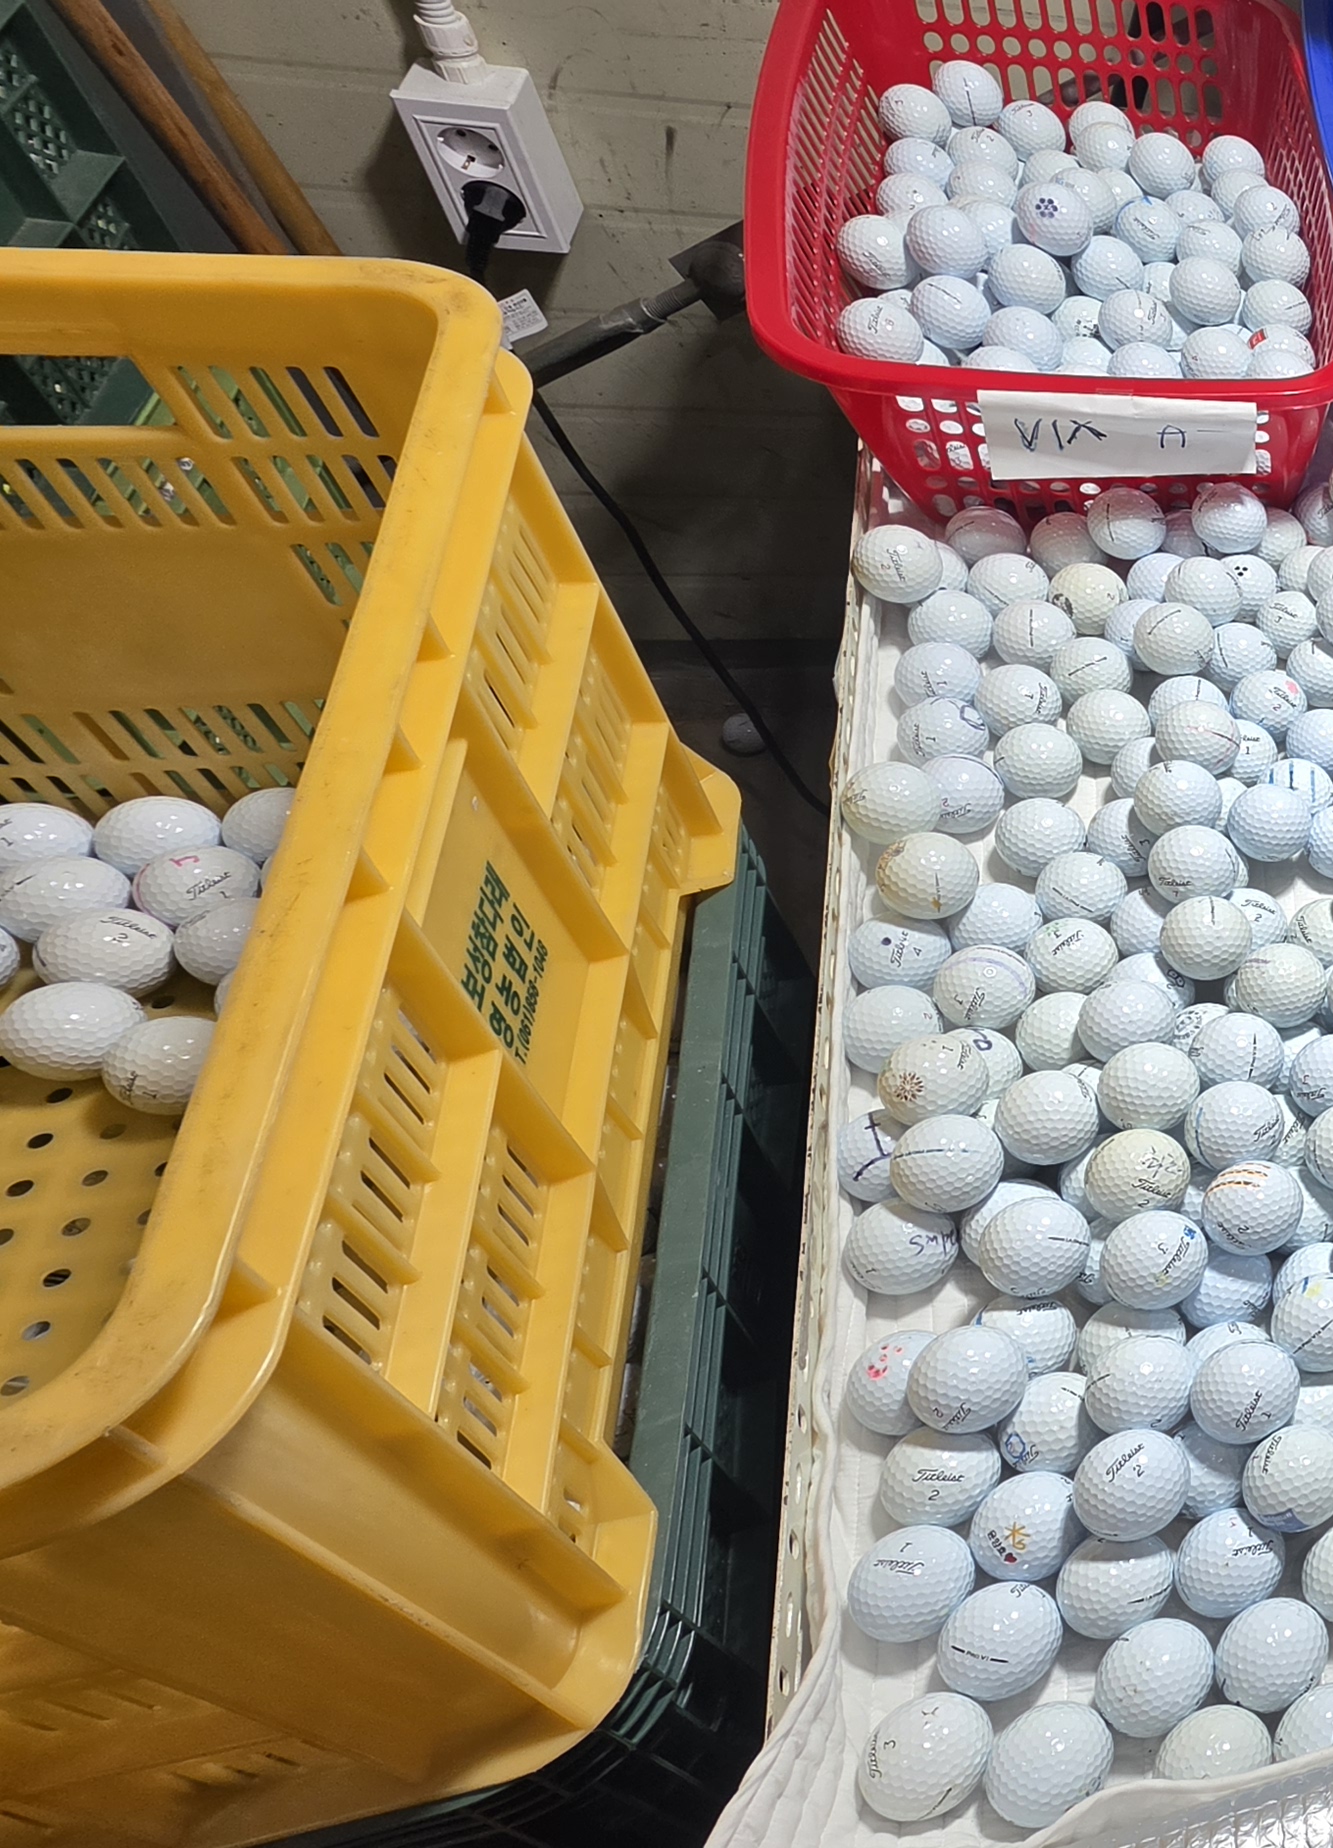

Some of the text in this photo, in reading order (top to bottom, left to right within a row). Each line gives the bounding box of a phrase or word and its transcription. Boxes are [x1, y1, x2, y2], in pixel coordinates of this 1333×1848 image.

[1273, 703, 1282, 712] 2
[1245, 746, 1251, 755] 1
[187, 872, 231, 900] Titleist
[1253, 913, 1262, 922] 2
[100, 916, 156, 940] Titleist
[461, 860, 510, 1012] 보성참다래
[913, 947, 922, 956] 4
[1131, 1179, 1171, 1198] Titleist
[1138, 1199, 1150, 1208] 2
[1238, 1224, 1249, 1233] 2
[933, 1407, 944, 1418] 2
[1236, 1391, 1262, 1431] Titleist
[1106, 1443, 1144, 1481] Titleist
[912, 1469, 964, 1483] Titleist
[1133, 1464, 1144, 1477] 2
[929, 1489, 940, 1500] 2
[900, 1542, 911, 1551] 1
[874, 1559, 925, 1576] Titleist
[884, 1740, 896, 1749] 3
